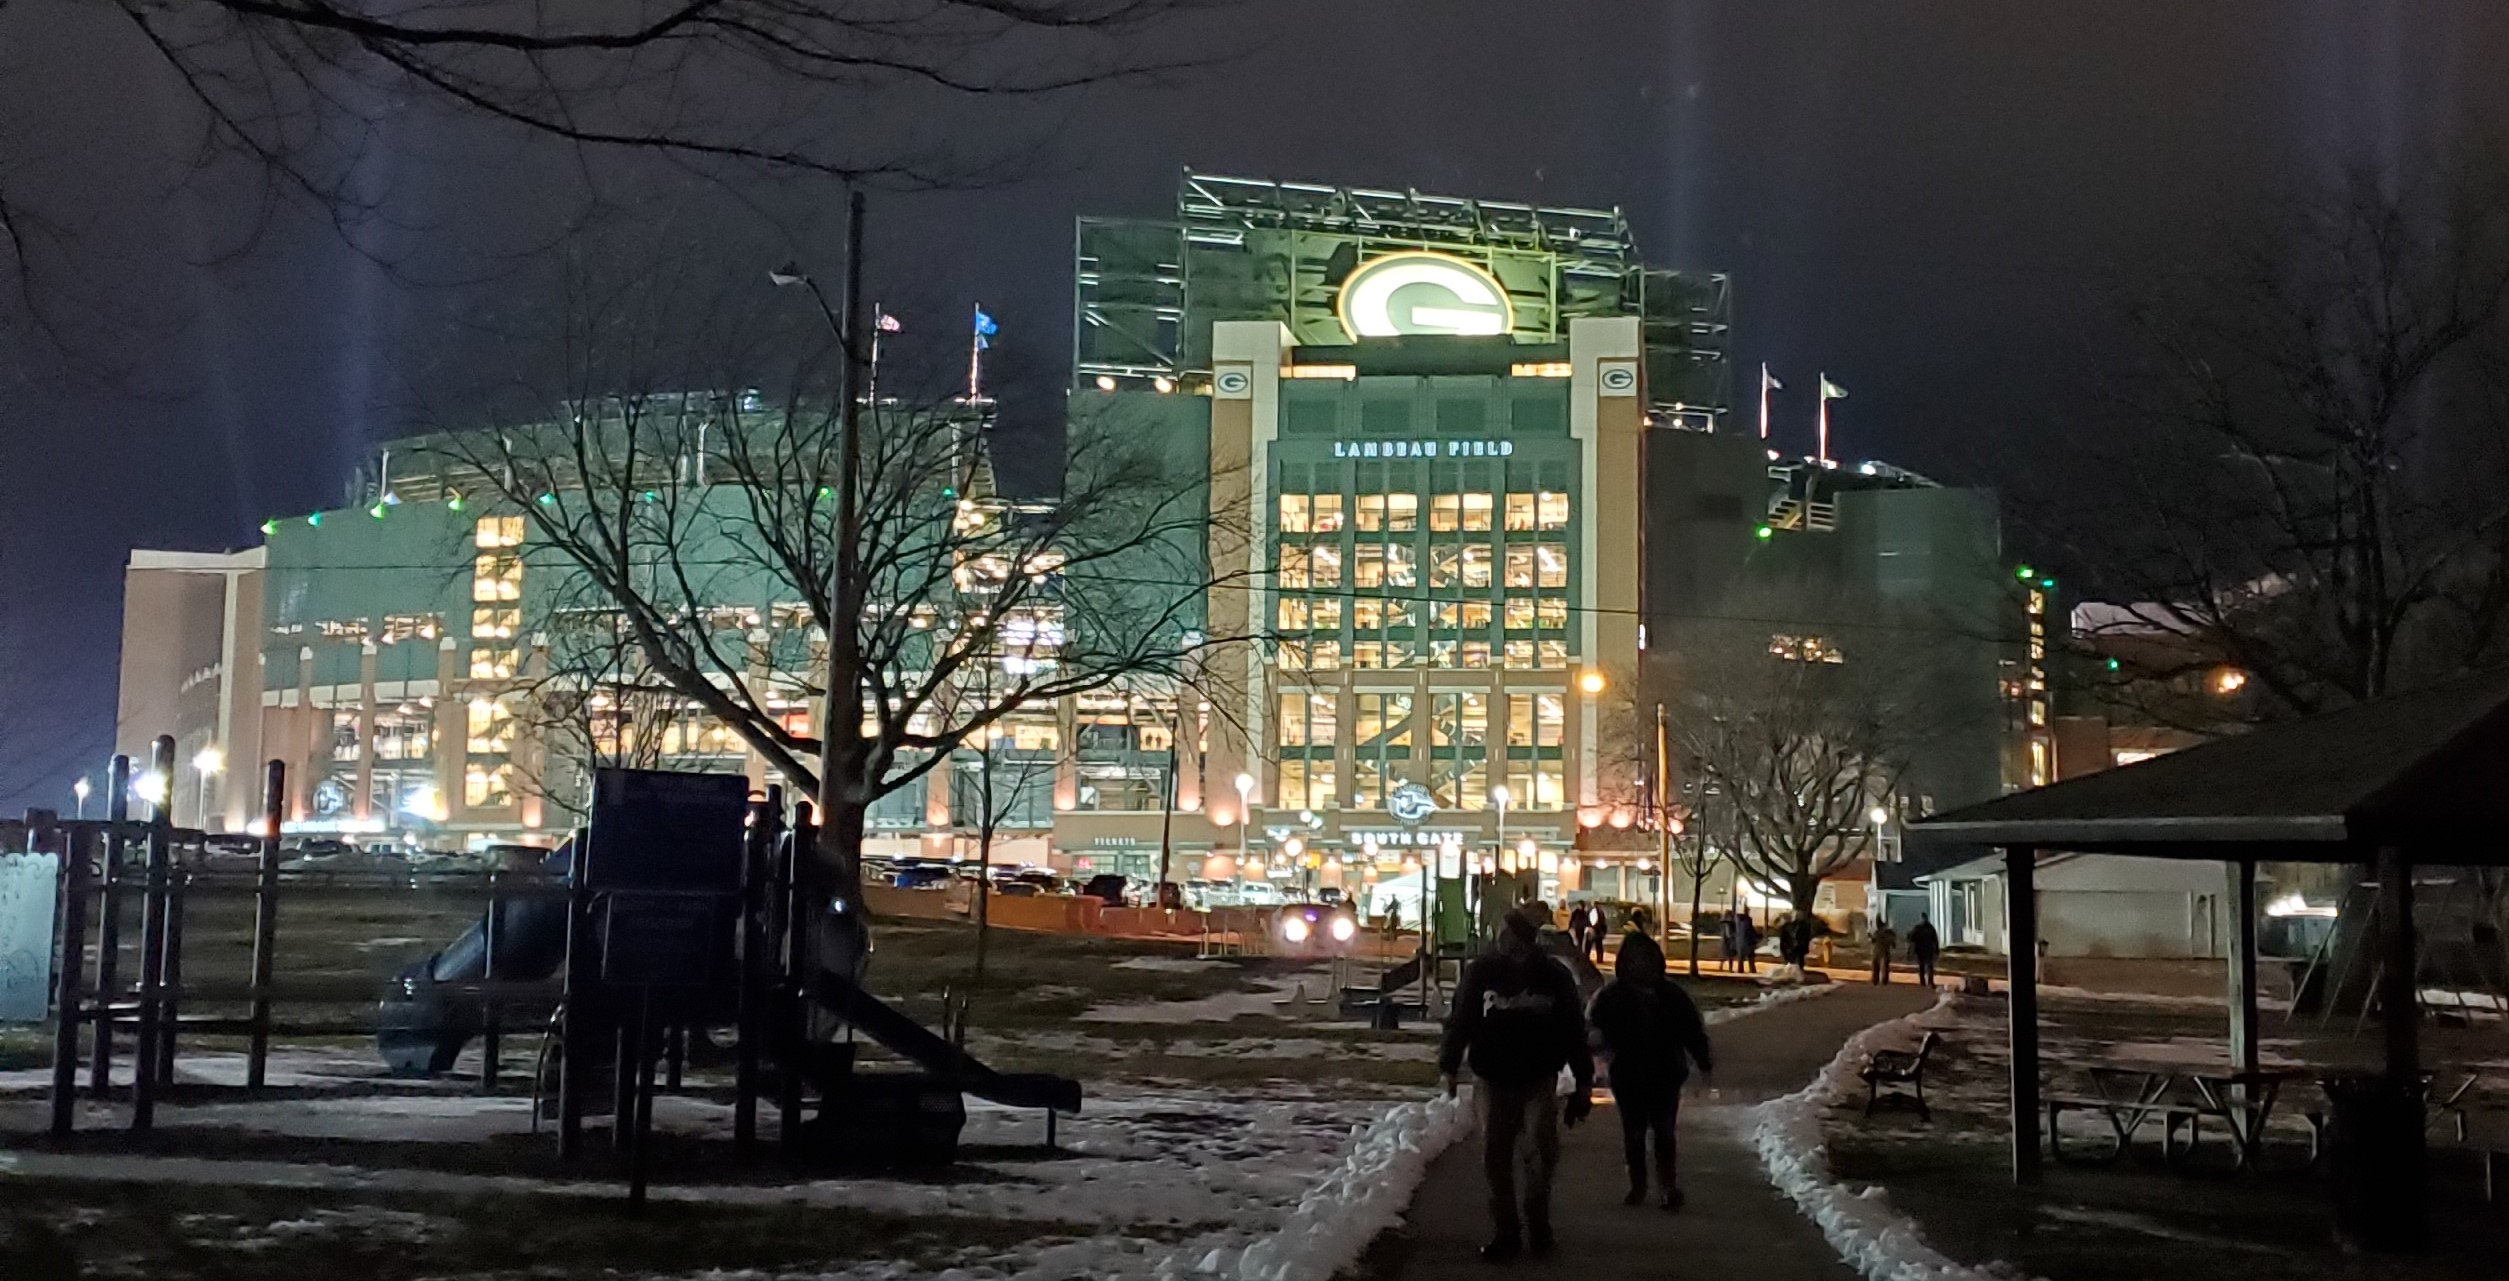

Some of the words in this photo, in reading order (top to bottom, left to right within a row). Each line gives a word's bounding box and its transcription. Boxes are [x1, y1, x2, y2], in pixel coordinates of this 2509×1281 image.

[1334, 441, 1437, 457] LAMBEAU
[1448, 440, 1513, 457] FIELD
[1351, 831, 1412, 846] SOUTH
[1416, 831, 1464, 846] GATE
